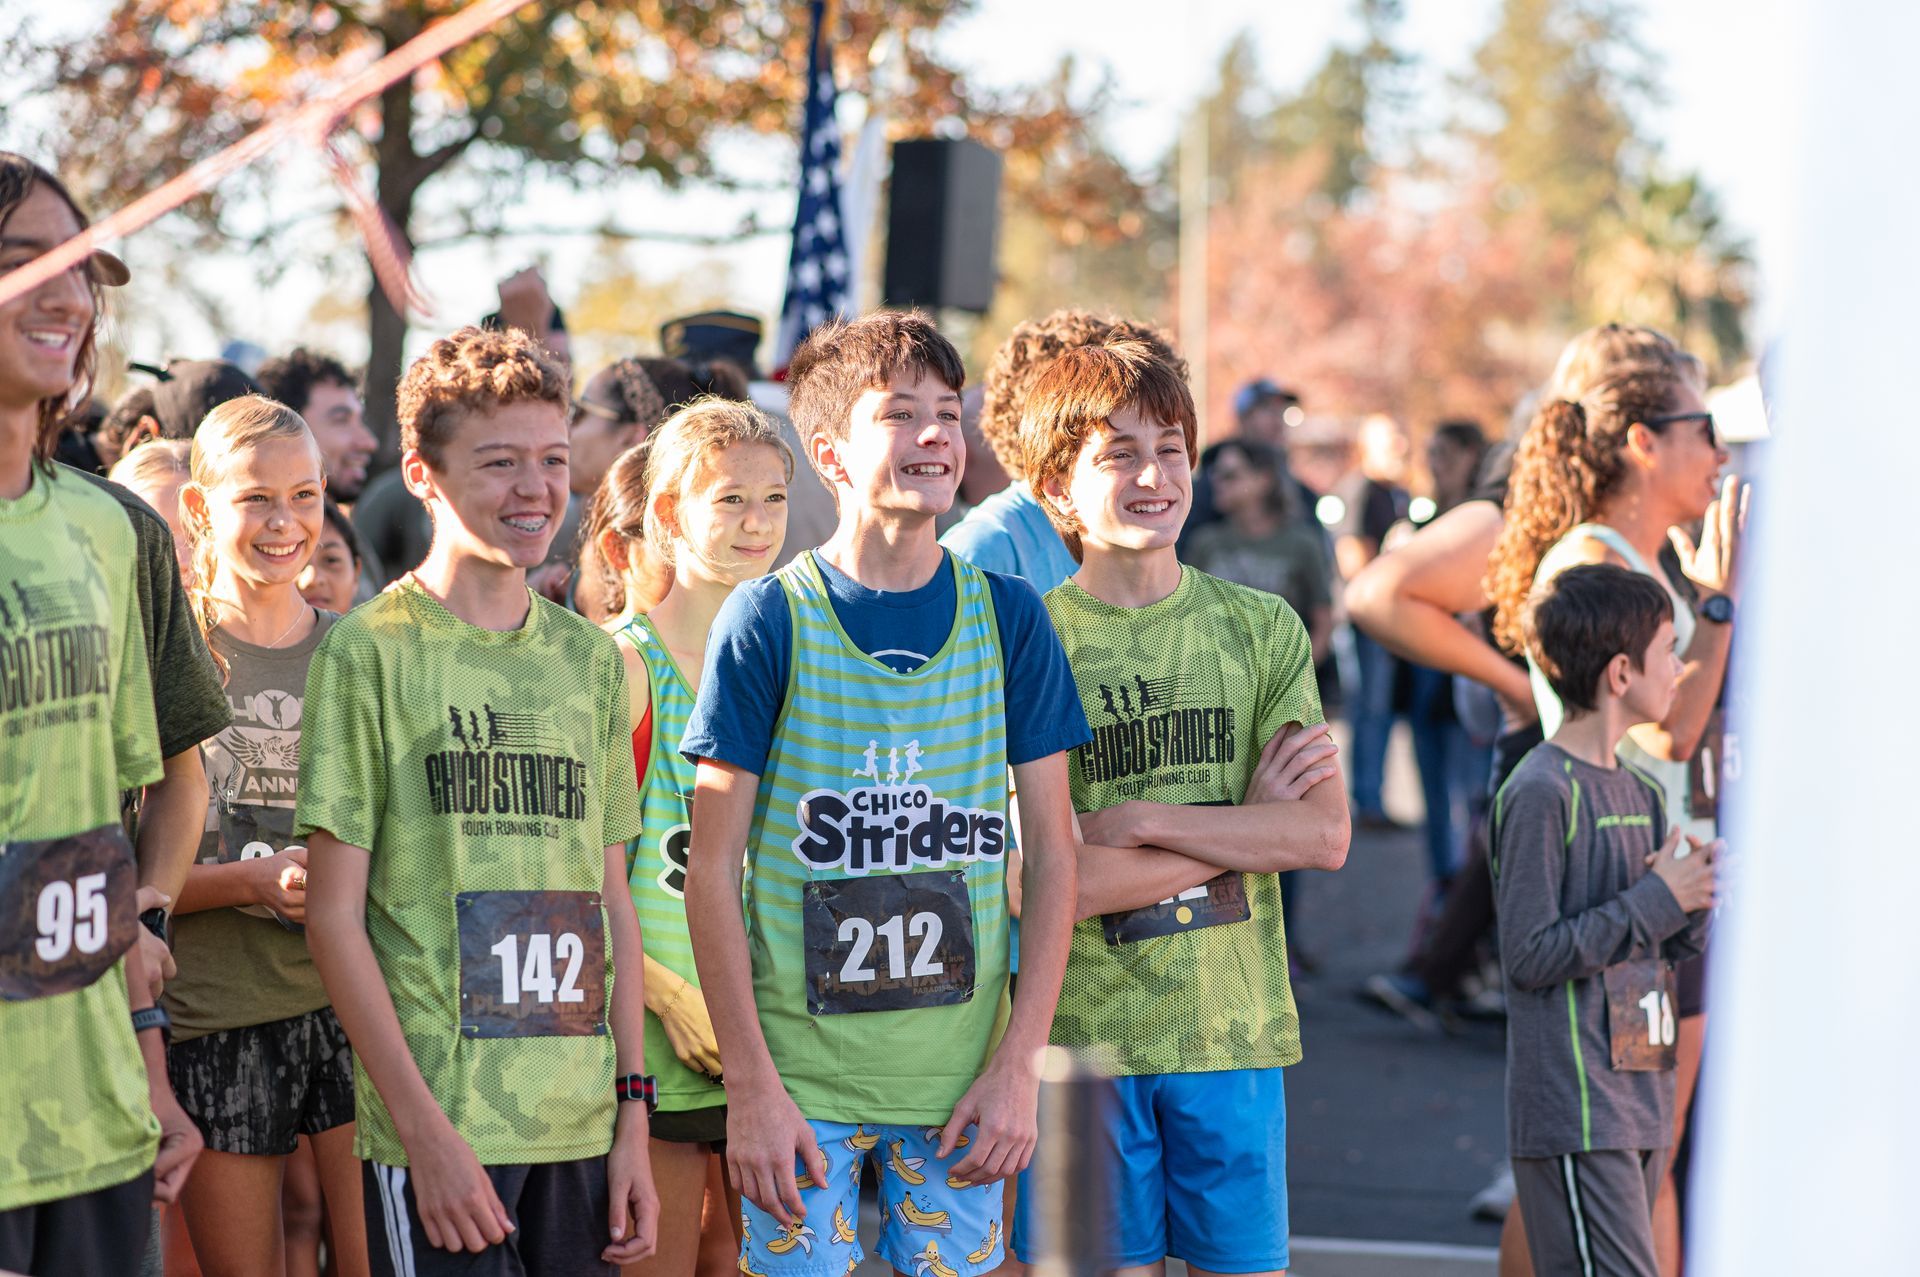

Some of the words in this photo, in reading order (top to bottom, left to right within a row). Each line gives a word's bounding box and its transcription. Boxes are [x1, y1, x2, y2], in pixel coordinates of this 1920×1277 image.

[1078, 718, 1147, 784] CHICO
[1147, 707, 1235, 770] STRIDERS
[245, 776, 298, 793] ANN
[425, 750, 490, 815] CHICO
[852, 789, 927, 815] CHICO
[1117, 780, 1145, 797] YOUT
[1188, 769, 1211, 784] CLUB
[798, 795, 1004, 869] Striders
[35, 872, 108, 962] 95
[837, 911, 944, 983] 212
[490, 932, 585, 1004] 142
